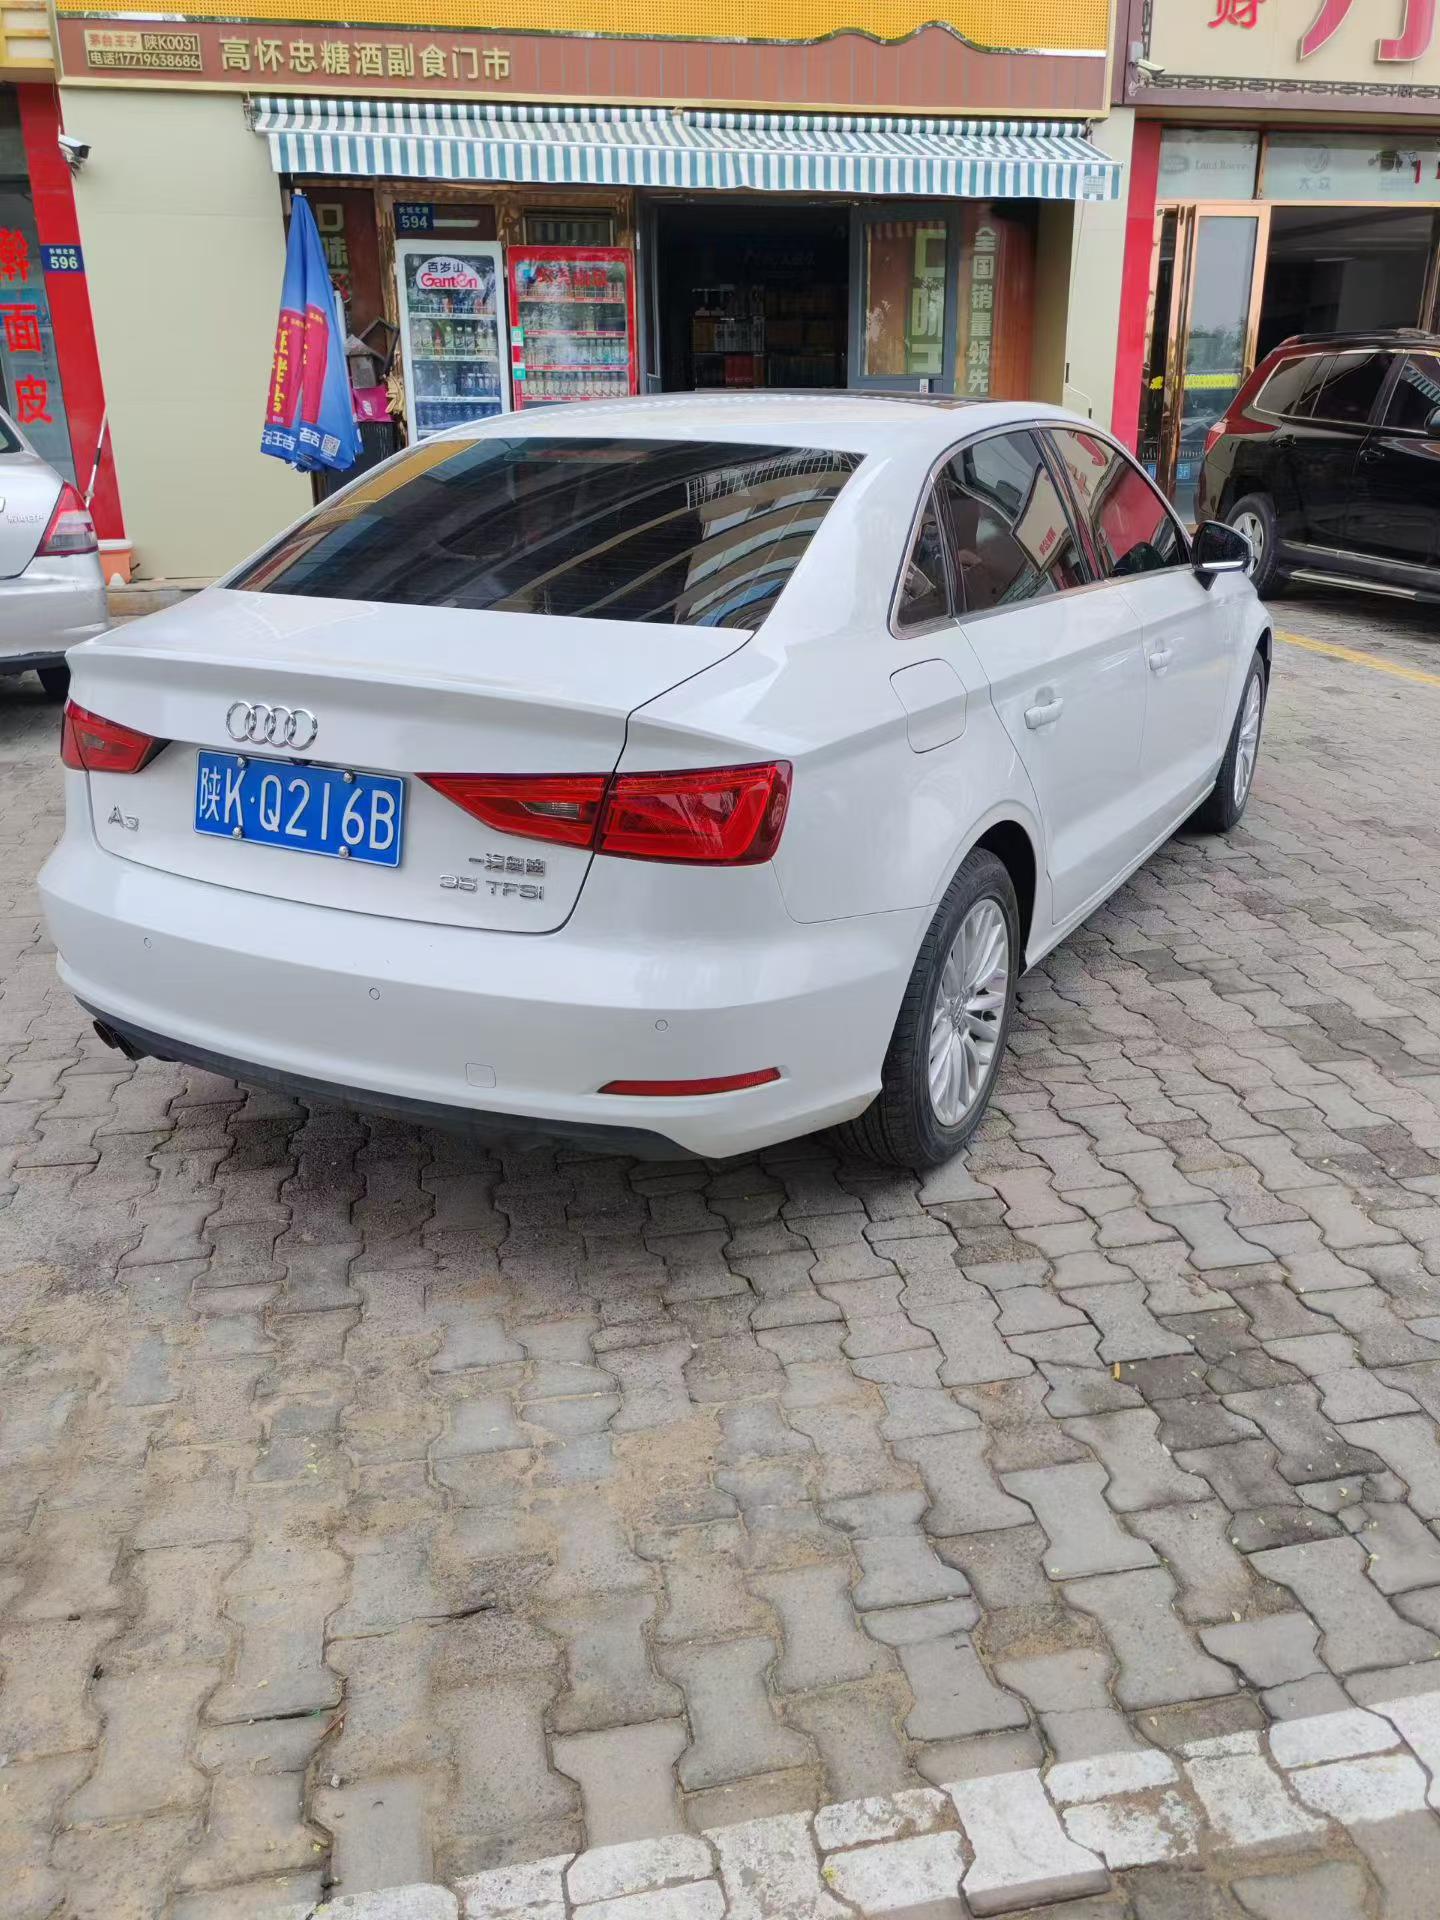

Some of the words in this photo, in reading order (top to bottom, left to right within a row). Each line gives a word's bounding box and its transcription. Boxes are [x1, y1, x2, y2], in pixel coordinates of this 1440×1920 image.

[143, 35, 196, 50] 陕K0031
[220, 36, 511, 80] 高怀忠糖酒副食门市
[401, 215, 428, 228] 594
[50, 256, 78, 269] 596
[427, 262, 464, 273] 百岁山
[421, 272, 478, 289] Ganten
[967, 226, 997, 393] 全国销量领先
[199, 765, 396, 850] 陕K·Q216B
[108, 806, 139, 832] A3
